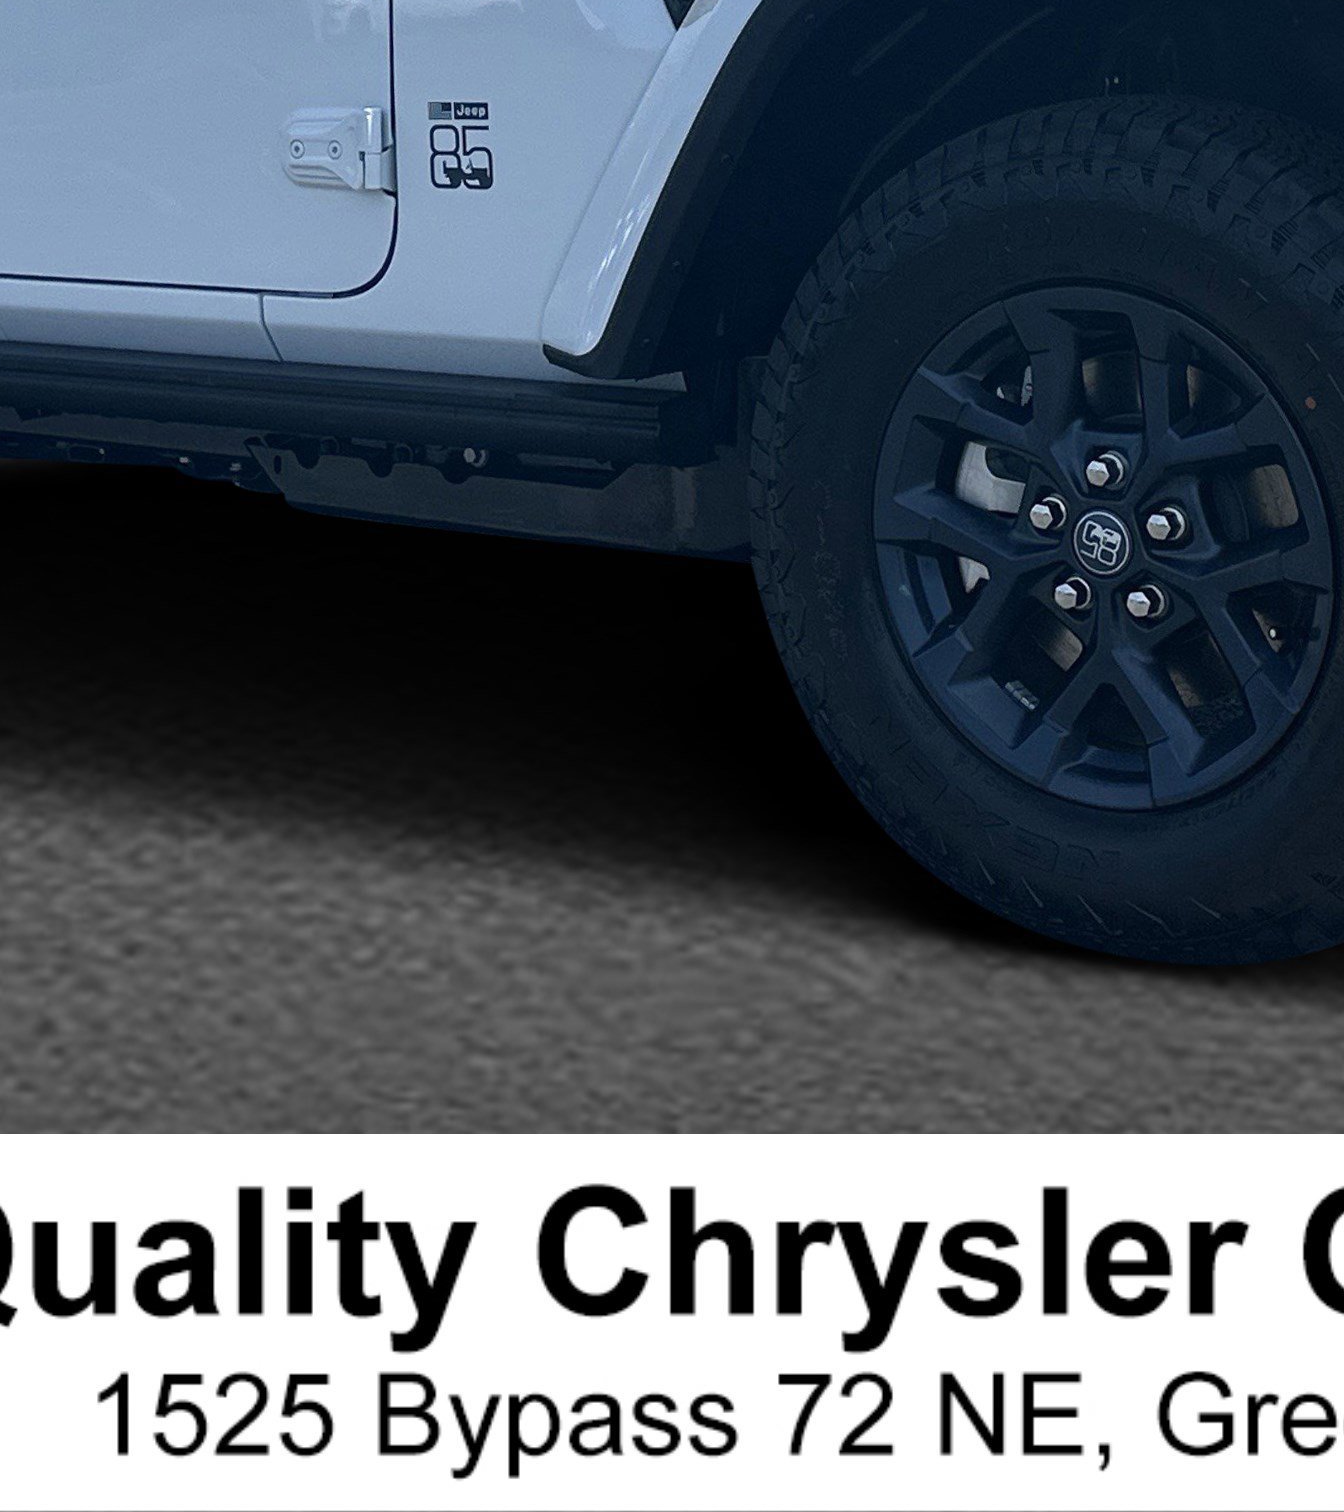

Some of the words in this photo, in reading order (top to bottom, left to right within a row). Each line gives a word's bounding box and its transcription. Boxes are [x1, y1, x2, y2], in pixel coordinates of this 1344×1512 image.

[456, 103, 487, 118] Jeep
[429, 124, 494, 190] 85
[1080, 520, 1123, 567] 85
